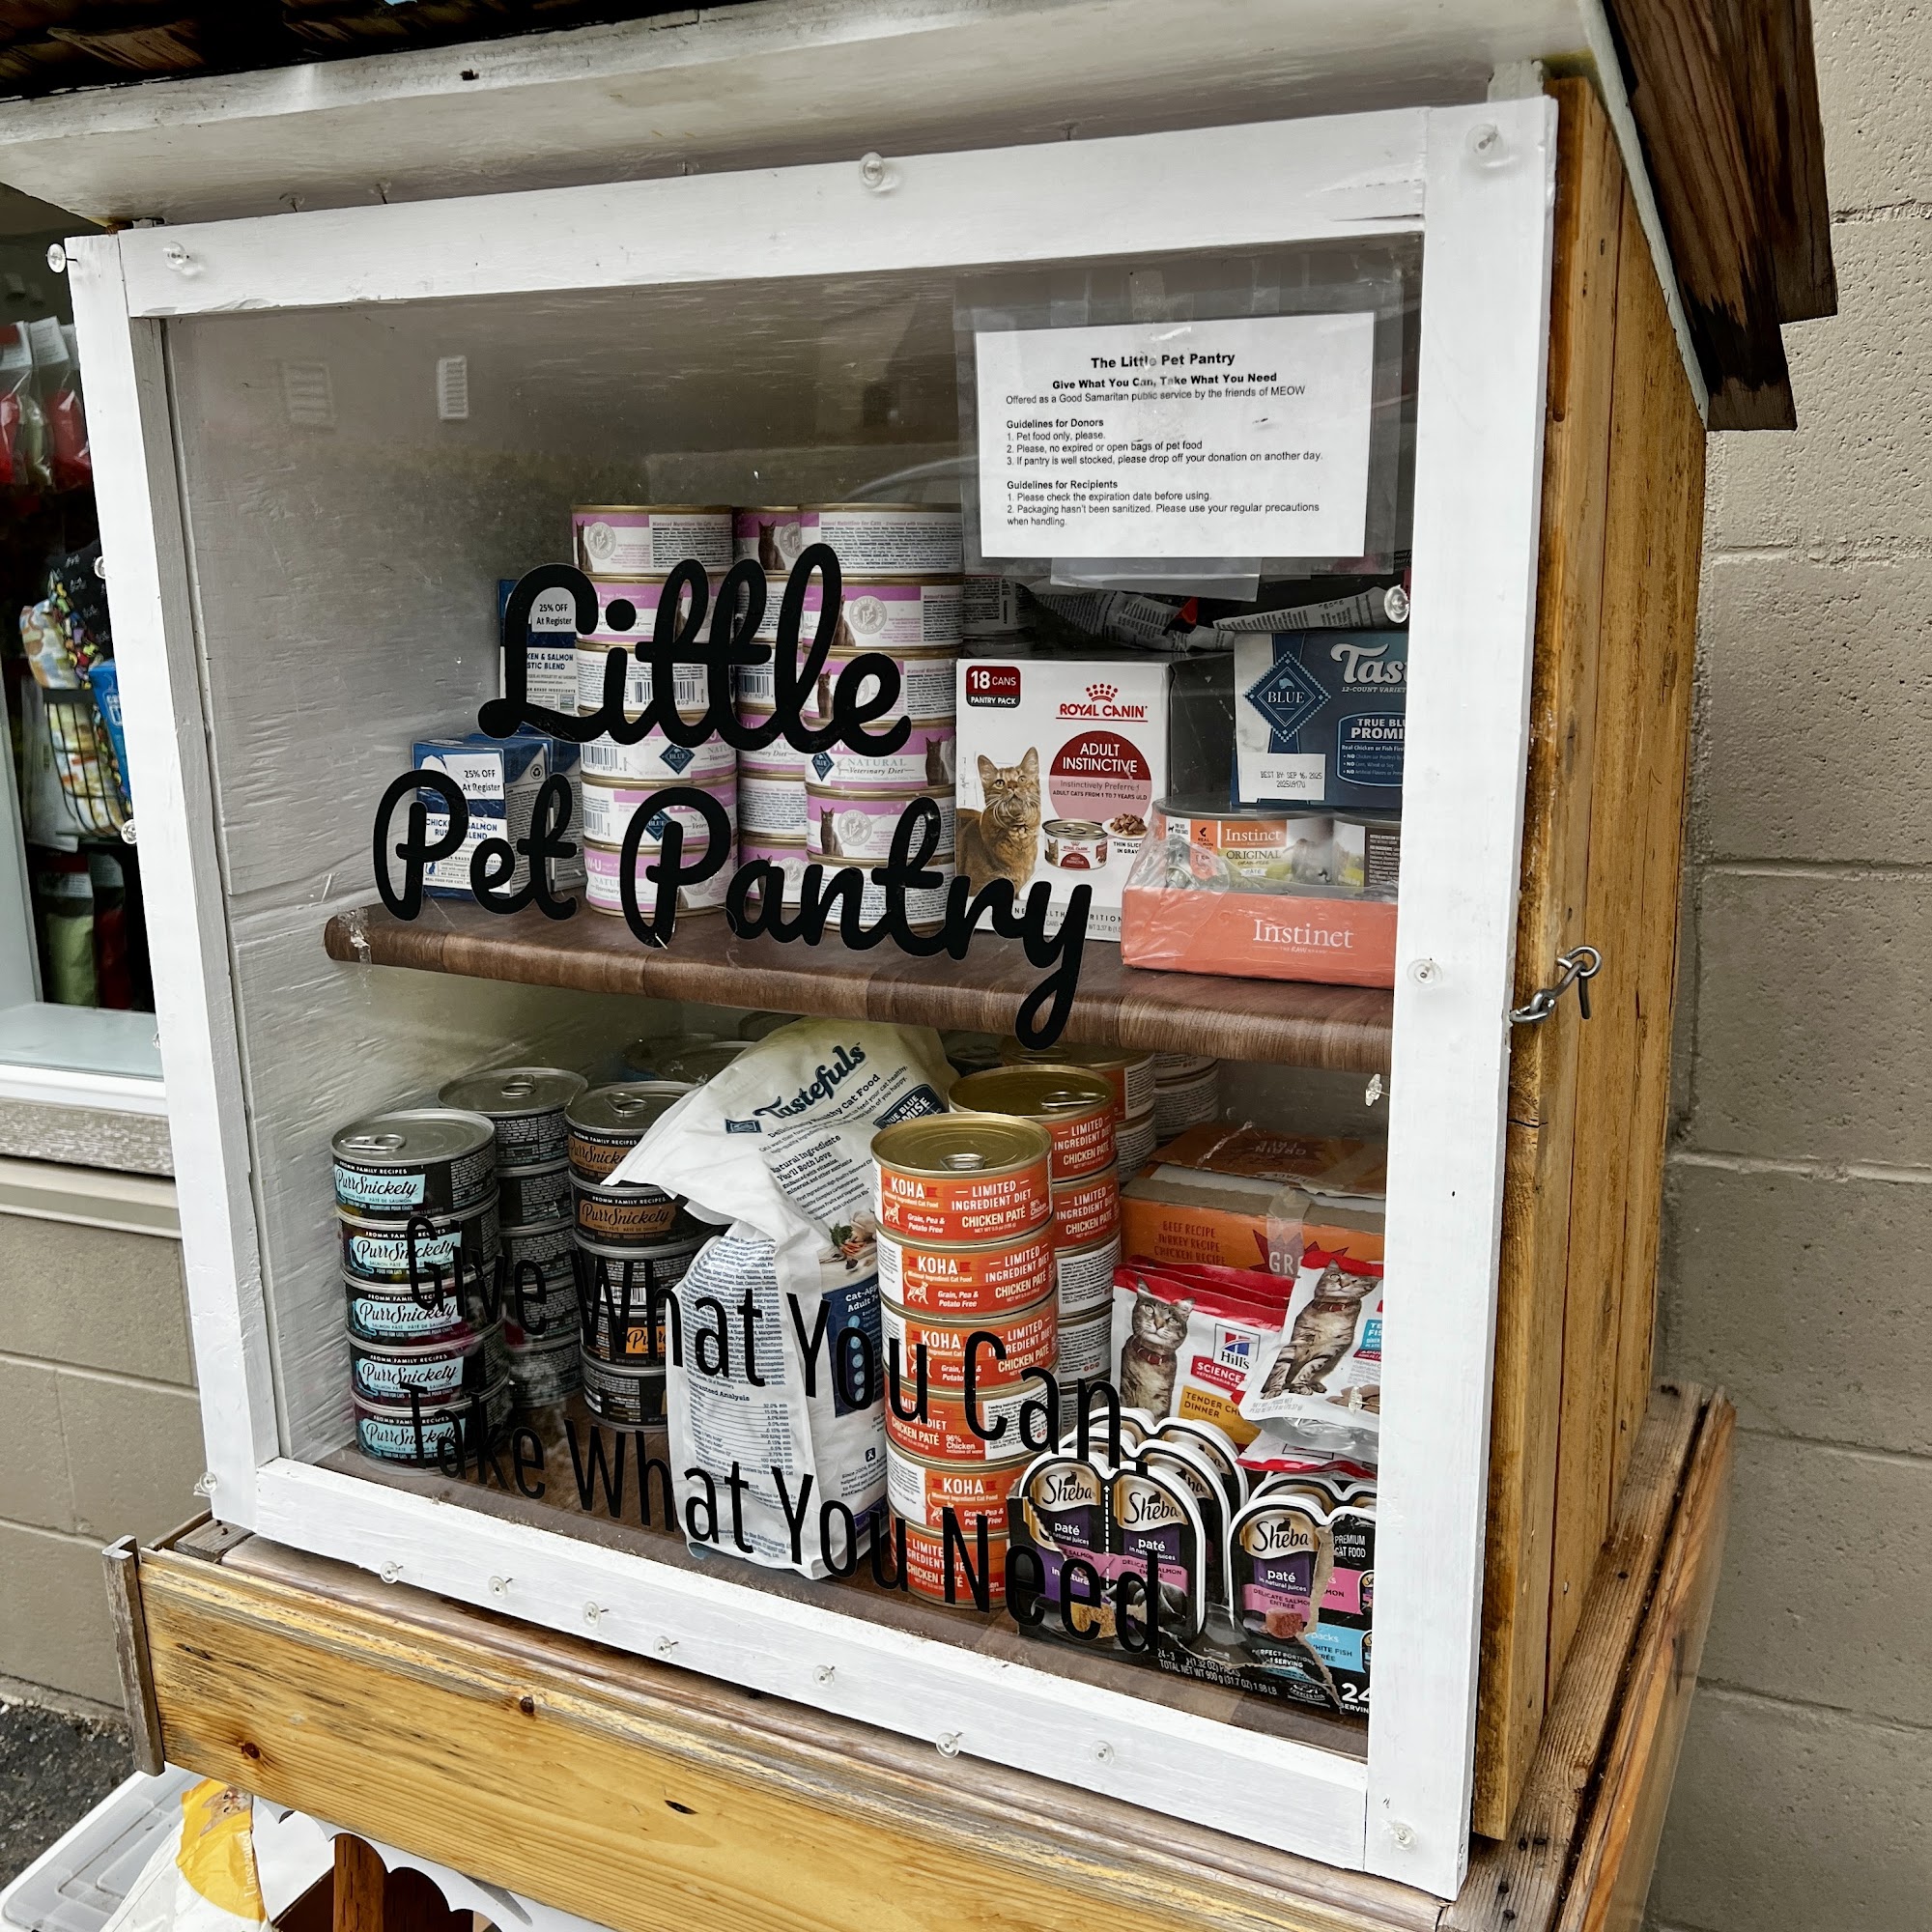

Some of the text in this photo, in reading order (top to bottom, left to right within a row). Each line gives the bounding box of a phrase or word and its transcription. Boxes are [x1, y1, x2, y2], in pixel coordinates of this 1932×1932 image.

[1090, 352, 1236, 369] The Little Pet Pantry
[1052, 371, 1278, 390] Give What You Can, Take What You Need
[1006, 384, 1306, 405] Offered as a Good Samaritan public service by the friends of MEOW
[1006, 417, 1104, 430] Guidelines for Donors
[1007, 430, 1106, 442] 1. Pet food only, please.
[1006, 440, 1203, 454] 2. Please, no expired or open bags of pet food
[1007, 450, 1323, 468] 3. If pantry is well stocked, please drop off your donation on another day.
[1007, 479, 1119, 492] Guidelines for Recipients
[1007, 490, 1212, 503] 1. Please check the expiration date before using.
[1007, 501, 1320, 516] 2. Packaging hasn't been sanitized. Please use your regular precautions
[1007, 516, 1067, 528] when handling.
[539, 603, 568, 612] 25% OFF
[536, 616, 572, 627] At Register
[477, 543, 912, 755] Little
[970, 670, 1016, 690] 18 CANS
[970, 696, 1016, 705] PANTRY PACK
[1267, 691, 1305, 703] BLUE
[1060, 703, 1147, 719] ROYAL CANIN
[1080, 742, 1121, 757] ADULT
[848, 758, 906, 767] NATURAL
[849, 766, 904, 776] Veterinary Diet
[1063, 756, 1138, 774] INSTINCTIVE
[465, 769, 496, 779] 25% OFF
[462, 782, 500, 792] At Register
[1225, 828, 1281, 841] Instinct
[1226, 849, 1281, 860] ORIGINAL
[373, 769, 1094, 1051] Pet Pantry
[1252, 919, 1354, 949] Instinct
[753, 1045, 867, 1120] Tastefuls
[335, 1169, 419, 1198] PurrSnickety
[892, 1177, 925, 1200] KOHA
[972, 1179, 1017, 1198] LIMITED
[952, 1188, 1032, 1211] INGREDIENT DIET
[582, 1203, 670, 1226] PurrSnickety
[961, 1205, 1026, 1228] CHICKEN PATÉ
[1162, 1220, 1216, 1238] BEEF RECIPE
[1158, 1234, 1221, 1253] TURKEY RECIPE
[918, 1256, 958, 1275] KOHA
[937, 1290, 958, 1299] Grain,
[938, 1299, 961, 1308] Potato
[407, 1215, 548, 1336] Give
[570, 1248, 766, 1387] What
[786, 1292, 928, 1425] You
[1220, 1350, 1250, 1370] Hill's
[362, 1362, 458, 1385] PurrSnickety
[1197, 1361, 1242, 1384] SCIENCE
[1185, 1391, 1223, 1410] TENDER
[1184, 1401, 1220, 1418] DINNER
[400, 1382, 547, 1500] Take
[564, 1417, 754, 1554] What
[770, 1465, 909, 1593] You
[943, 1477, 985, 1494] KOHA
[1041, 1474, 1093, 1505] Sheba
[1123, 1492, 1179, 1524] Sheba
[1054, 1521, 1080, 1536] paté
[1252, 1520, 1310, 1552] Sheba
[1334, 1534, 1366, 1546] PREMIUM
[1334, 1547, 1366, 1558] CAT FOOD
[1266, 1569, 1296, 1583] paté
[237, 1830, 258, 1898] Unscented
